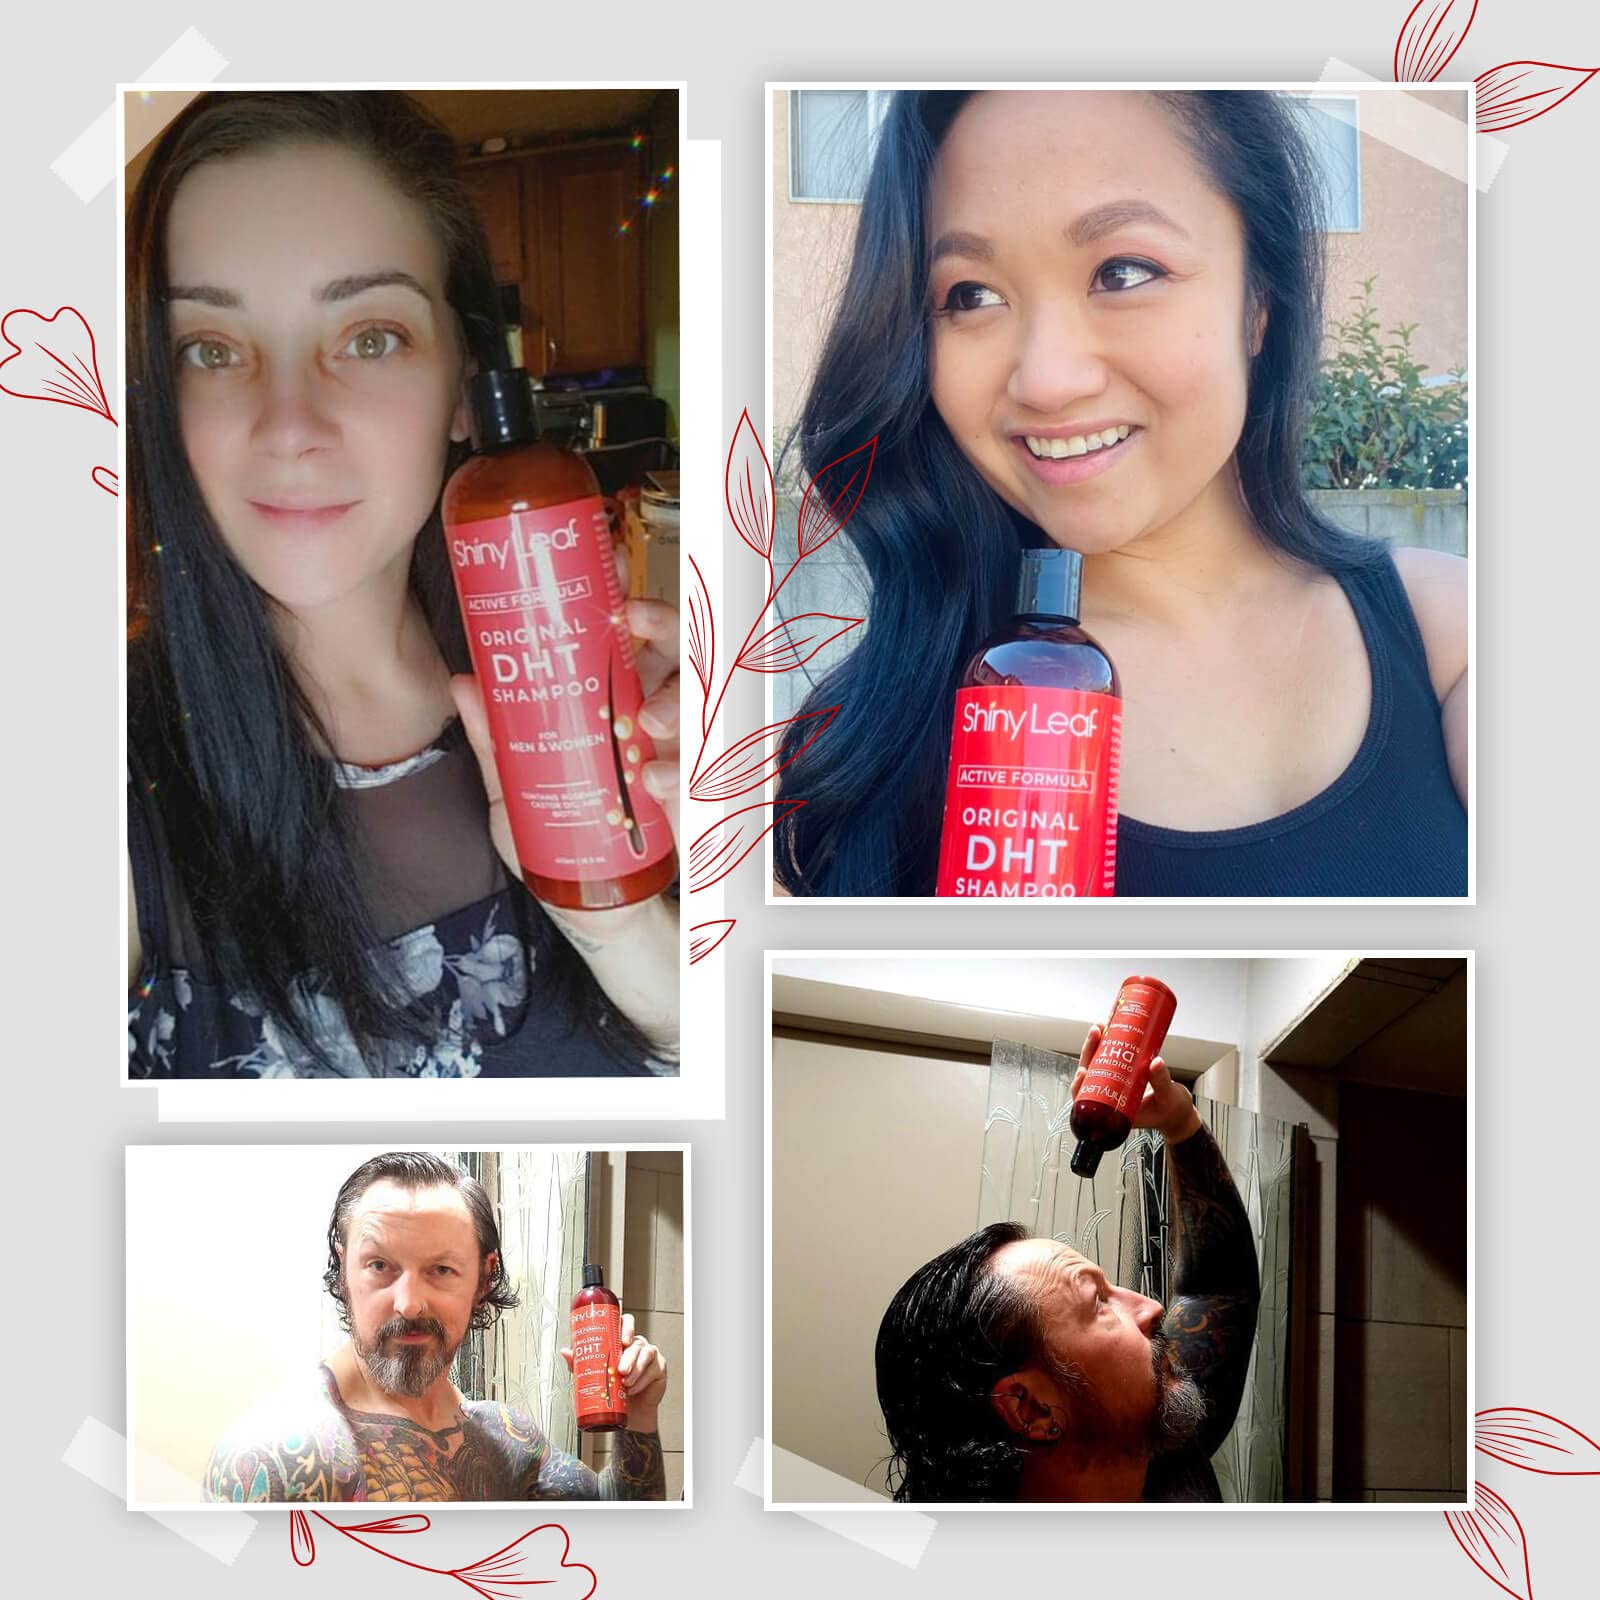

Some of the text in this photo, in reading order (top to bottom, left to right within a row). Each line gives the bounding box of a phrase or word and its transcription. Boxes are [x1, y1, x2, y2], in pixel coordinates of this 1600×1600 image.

[453, 537, 510, 570] Shiny
[468, 582, 586, 610] ACTIVE FORULA
[491, 642, 580, 684] DHT
[492, 676, 600, 704] SHAMPOO
[962, 701, 1099, 741] Shiny Leaf
[509, 741, 535, 752] MEN
[547, 732, 605, 752] WOMEN
[538, 731, 558, 740] FOR
[959, 769, 1088, 789] ACTIVE FORMULA
[962, 807, 1080, 831] ORIGINAL
[965, 834, 1068, 875] DHT
[955, 877, 1075, 897] SHAMPOO
[1100, 1047, 1135, 1063] DHT
[575, 1343, 602, 1357] DHT
